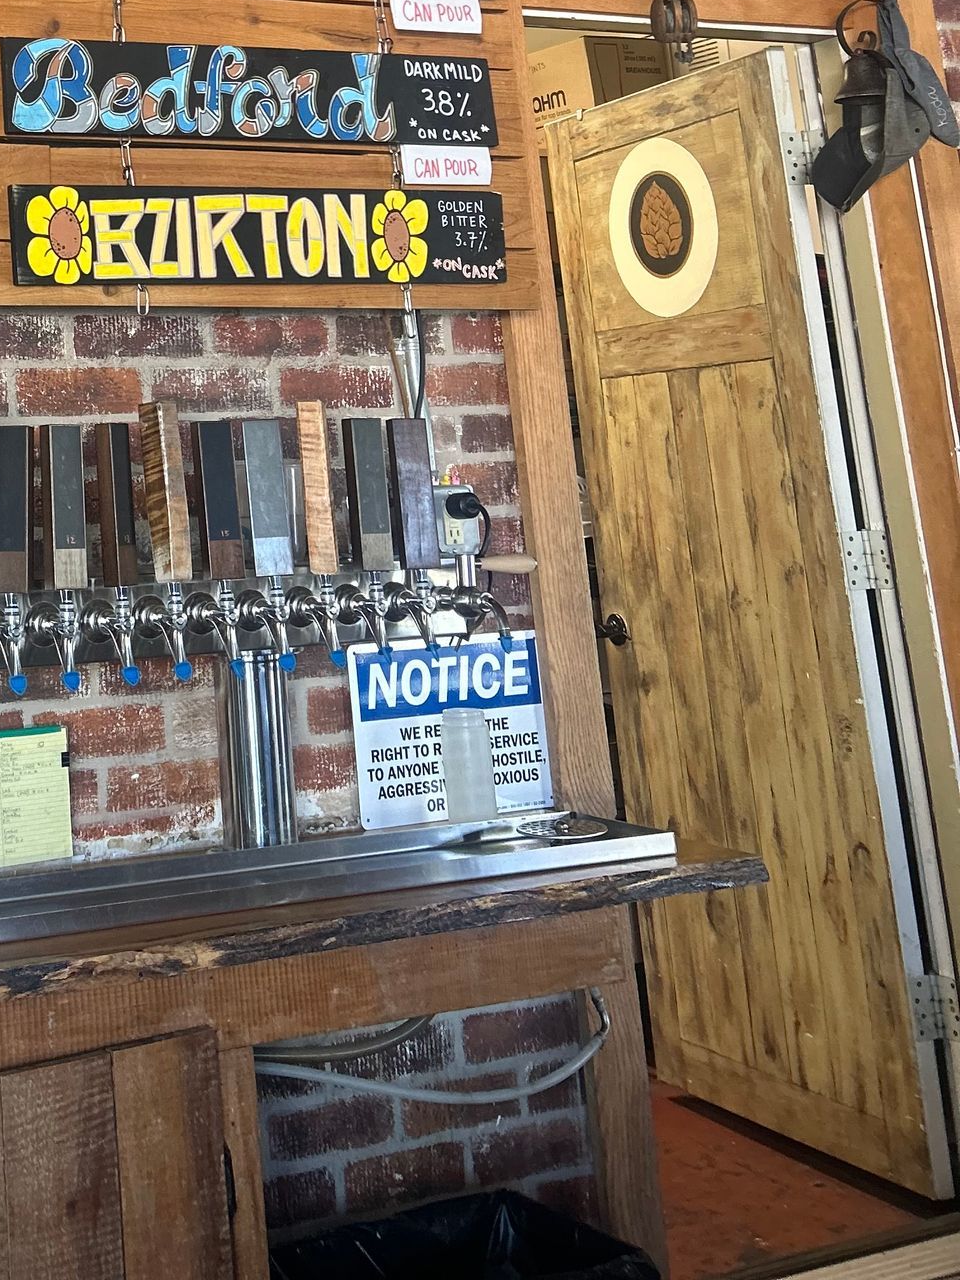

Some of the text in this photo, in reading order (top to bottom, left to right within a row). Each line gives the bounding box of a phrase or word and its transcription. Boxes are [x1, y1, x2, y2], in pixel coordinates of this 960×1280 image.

[402, 0, 474, 22] CAN POUR
[404, 60, 483, 82] DARK MILD
[10, 37, 398, 142] Bedford
[421, 88, 472, 117] 3.8%
[414, 157, 479, 178] CAN POUR
[437, 200, 483, 213] GOLDEN
[441, 214, 487, 228] BITTER
[89, 194, 371, 280] BURTON
[454, 231, 488, 252] 3.7%
[367, 651, 529, 710] NOTICE
[400, 726, 421, 741] WE
[485, 717, 509, 731] THE
[371, 746, 410, 763] RIGHT
[413, 744, 429, 758] TO
[492, 749, 546, 767] HOSTILE,
[367, 761, 439, 782] TO ANYONE
[378, 778, 446, 800] AGGRESSI
[427, 798, 445, 812] OR
